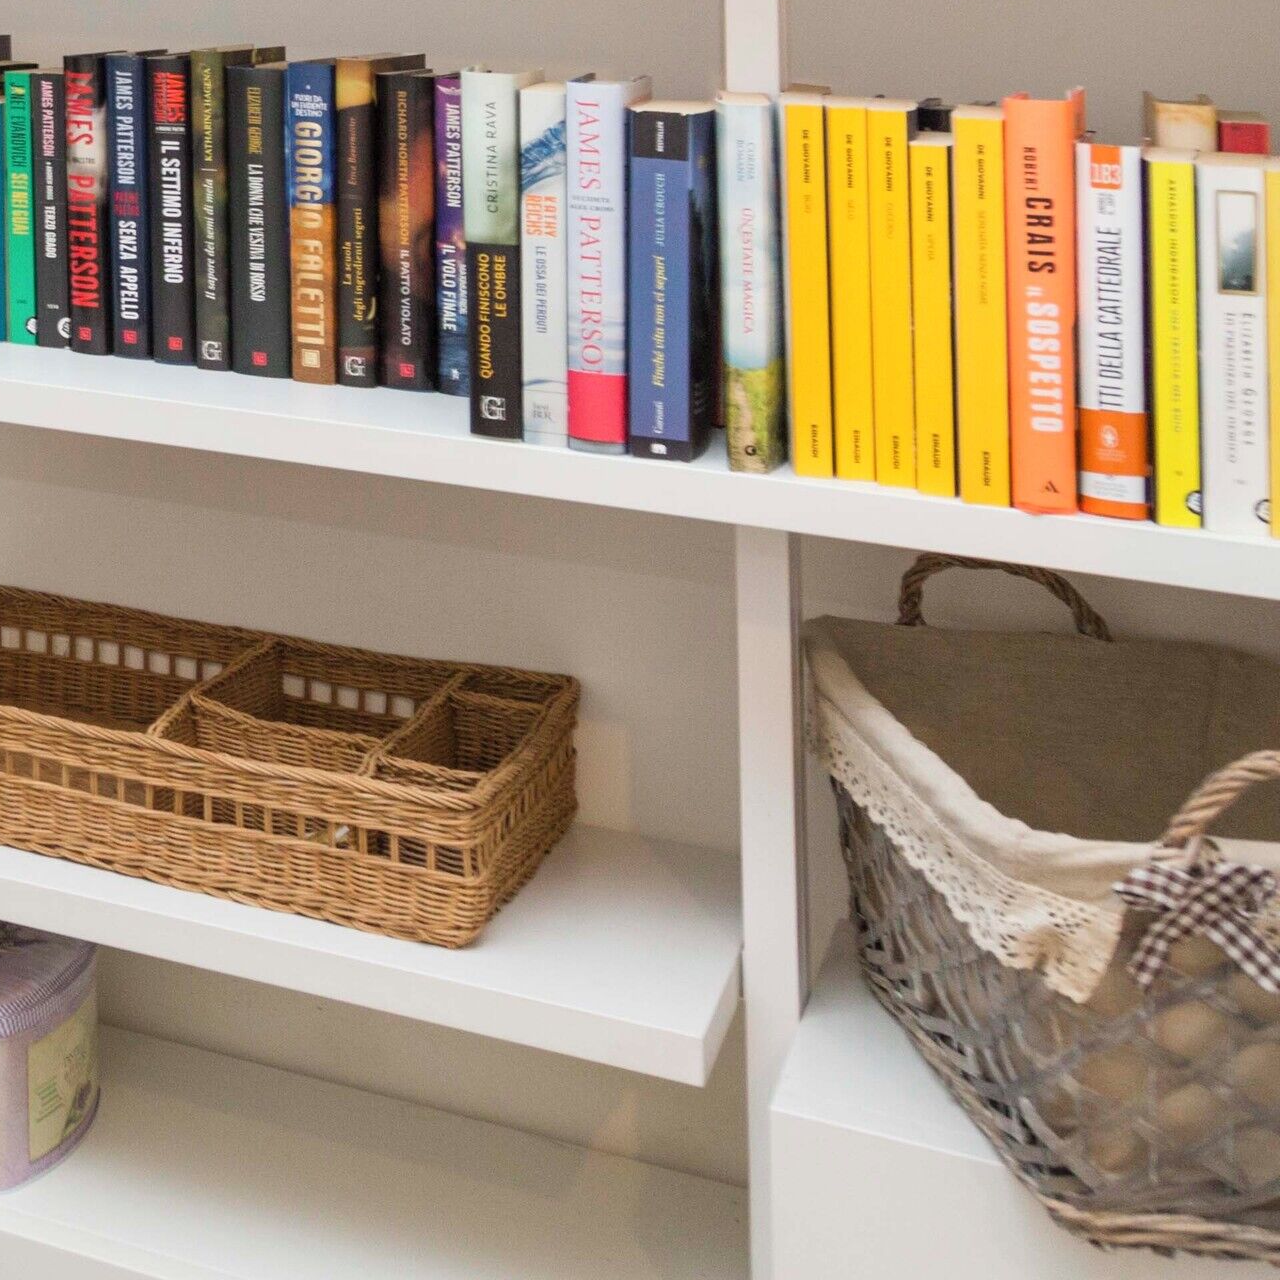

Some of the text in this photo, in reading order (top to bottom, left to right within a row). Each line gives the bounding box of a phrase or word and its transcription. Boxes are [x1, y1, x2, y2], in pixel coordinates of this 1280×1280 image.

[65, 71, 99, 309] JAMES PATTERSON
[485, 102, 499, 213] CRISTINA RAVA
[575, 100, 601, 190] JAMES
[977, 144, 985, 155] DE
[1023, 146, 1037, 191] ROBERT
[114, 70, 139, 320] JAMES PATTERSON SENZA APPELLO
[294, 121, 325, 344] GIORGIO FALETTI
[442, 104, 462, 331] JAMES PATTERSON IL VOLO FINALE
[525, 194, 542, 237] REICHS
[542, 196, 558, 238] KATHY
[1025, 197, 1056, 275] CRAIS
[477, 254, 493, 378] QUANDO FINISCONO
[493, 255, 507, 319] LE OMBRE
[535, 246, 548, 334] LE OSSA DEI PERDUTI
[1095, 226, 1123, 325] CATTEDRALE
[1026, 302, 1064, 433] SOSPETTO
[1098, 331, 1123, 379] DELLA
[1241, 312, 1258, 447] ELIZABETH GEORGE
[982, 451, 991, 487] EINAUDI
